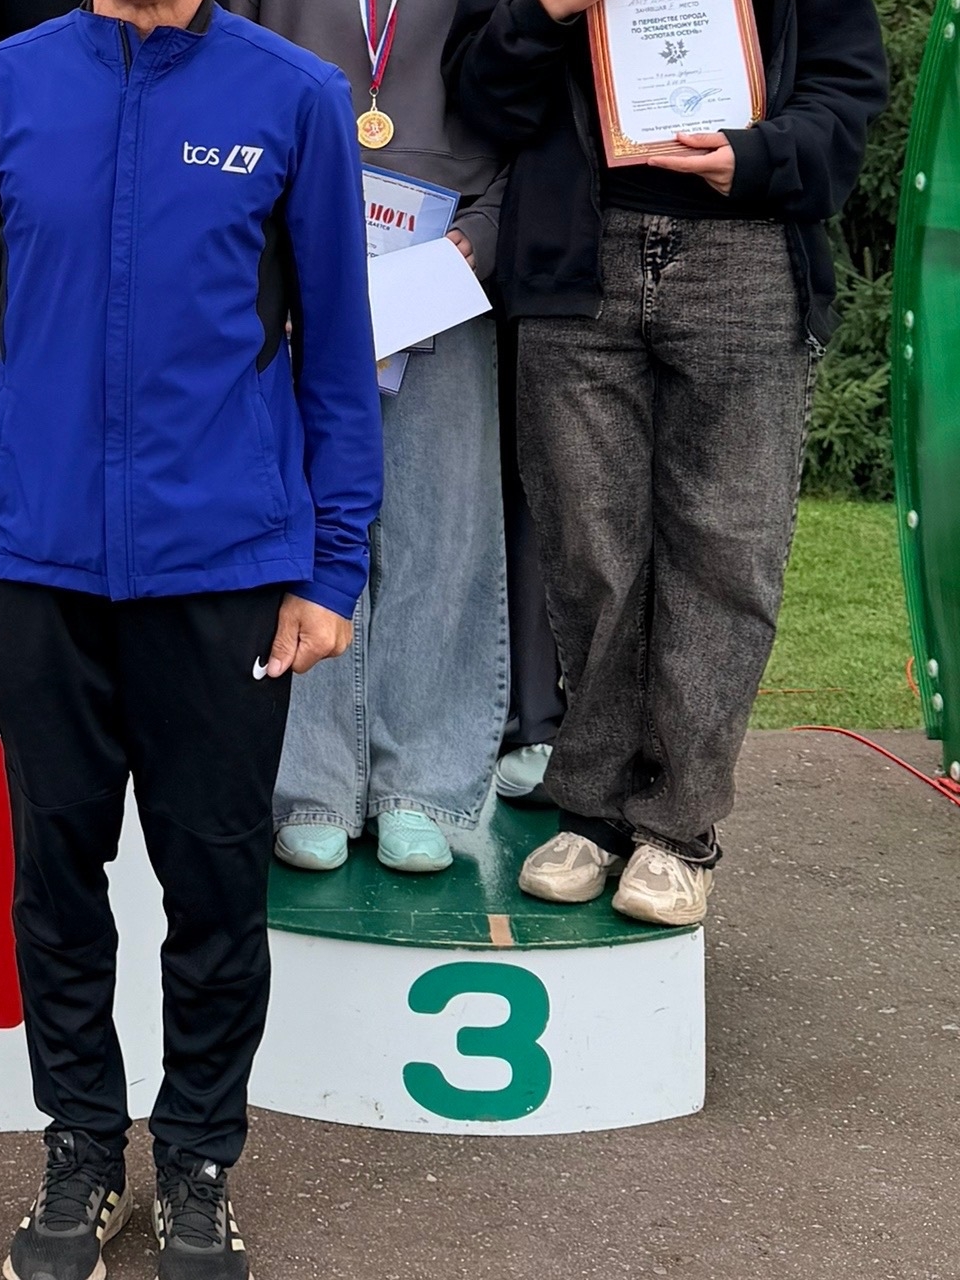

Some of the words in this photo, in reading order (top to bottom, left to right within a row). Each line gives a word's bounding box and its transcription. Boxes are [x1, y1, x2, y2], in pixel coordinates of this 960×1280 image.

[638, 15, 678, 25] ПЕРВЕНСТВЕ
[679, 12, 707, 21] ГОРОДА
[643, 21, 692, 33] ЭСТАФЕТНОМУ
[693, 19, 710, 27] БЕГУ
[183, 141, 220, 166] tcs
[369, 202, 416, 232] МОТА
[403, 962, 552, 1120] 3
